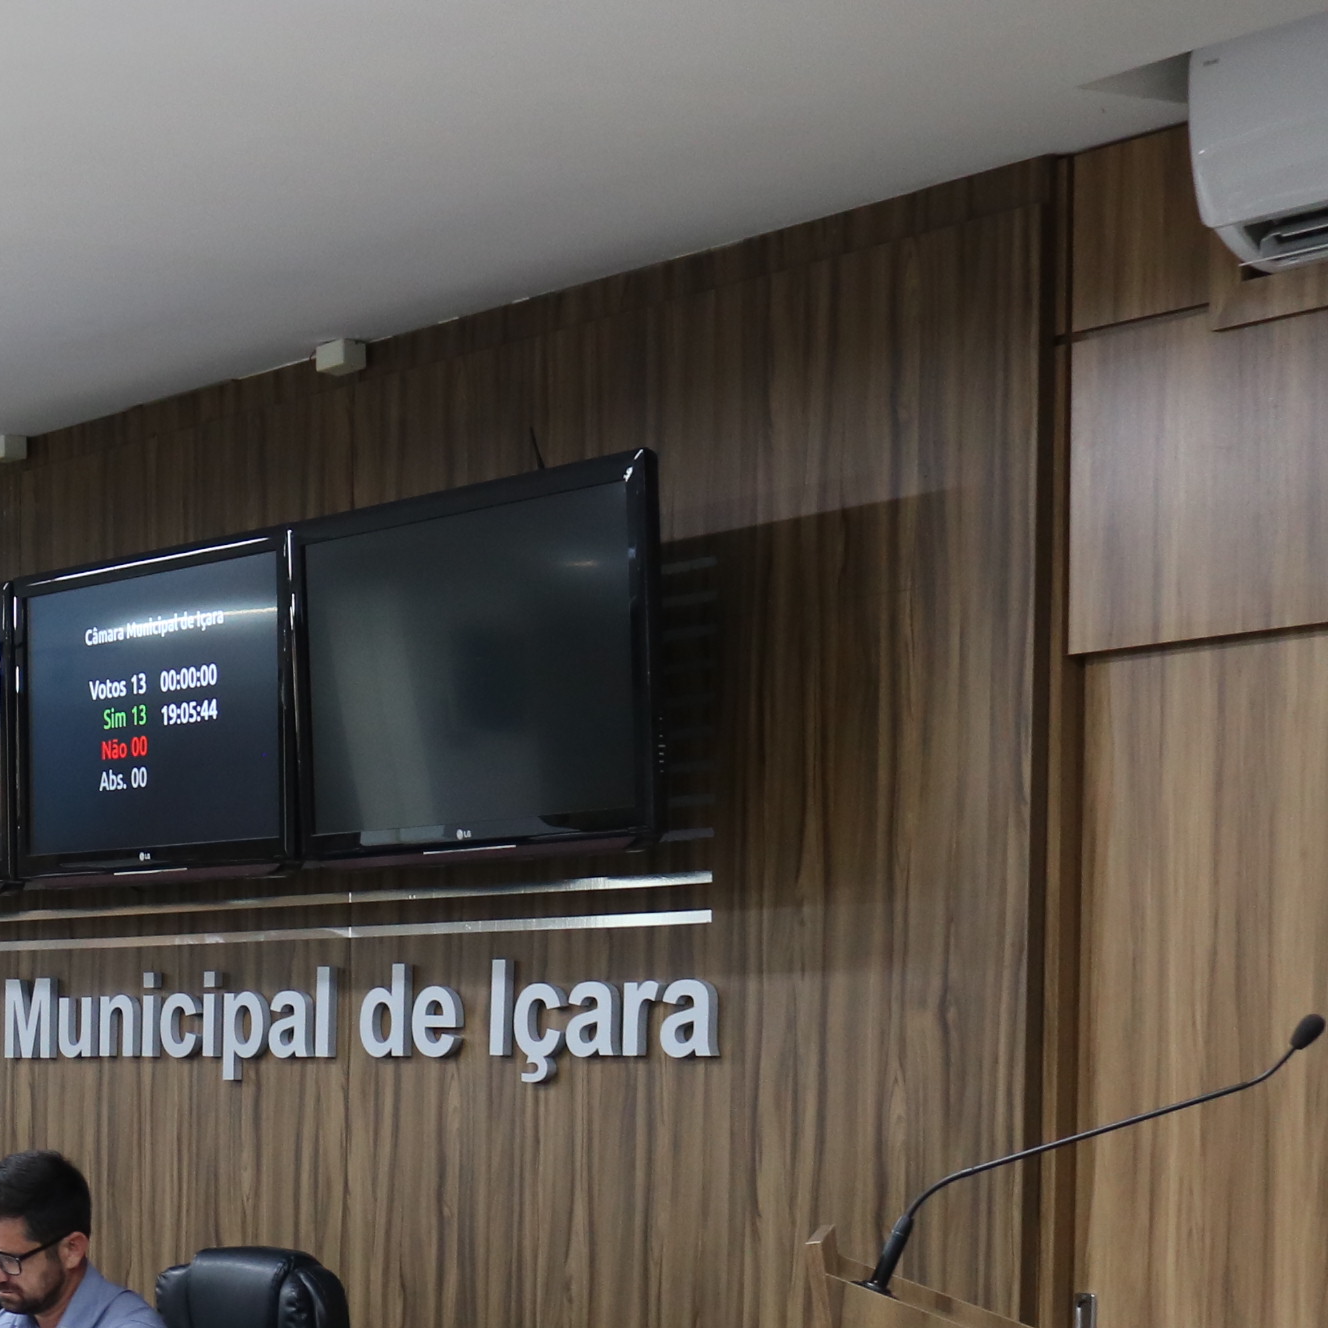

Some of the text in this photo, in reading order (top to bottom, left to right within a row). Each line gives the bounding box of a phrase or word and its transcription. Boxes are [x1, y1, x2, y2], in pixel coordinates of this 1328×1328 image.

[85, 610, 224, 646] Câmara Municipal de Içara
[89, 663, 218, 701] Votos 13 00:00:00
[103, 699, 218, 730] Sim 13 19:05:44
[101, 735, 148, 760] Não 00
[99, 767, 148, 792] Abs. 00
[4, 966, 337, 1081] Municipal
[359, 963, 464, 1058] de
[489, 958, 720, 1083] Içara
